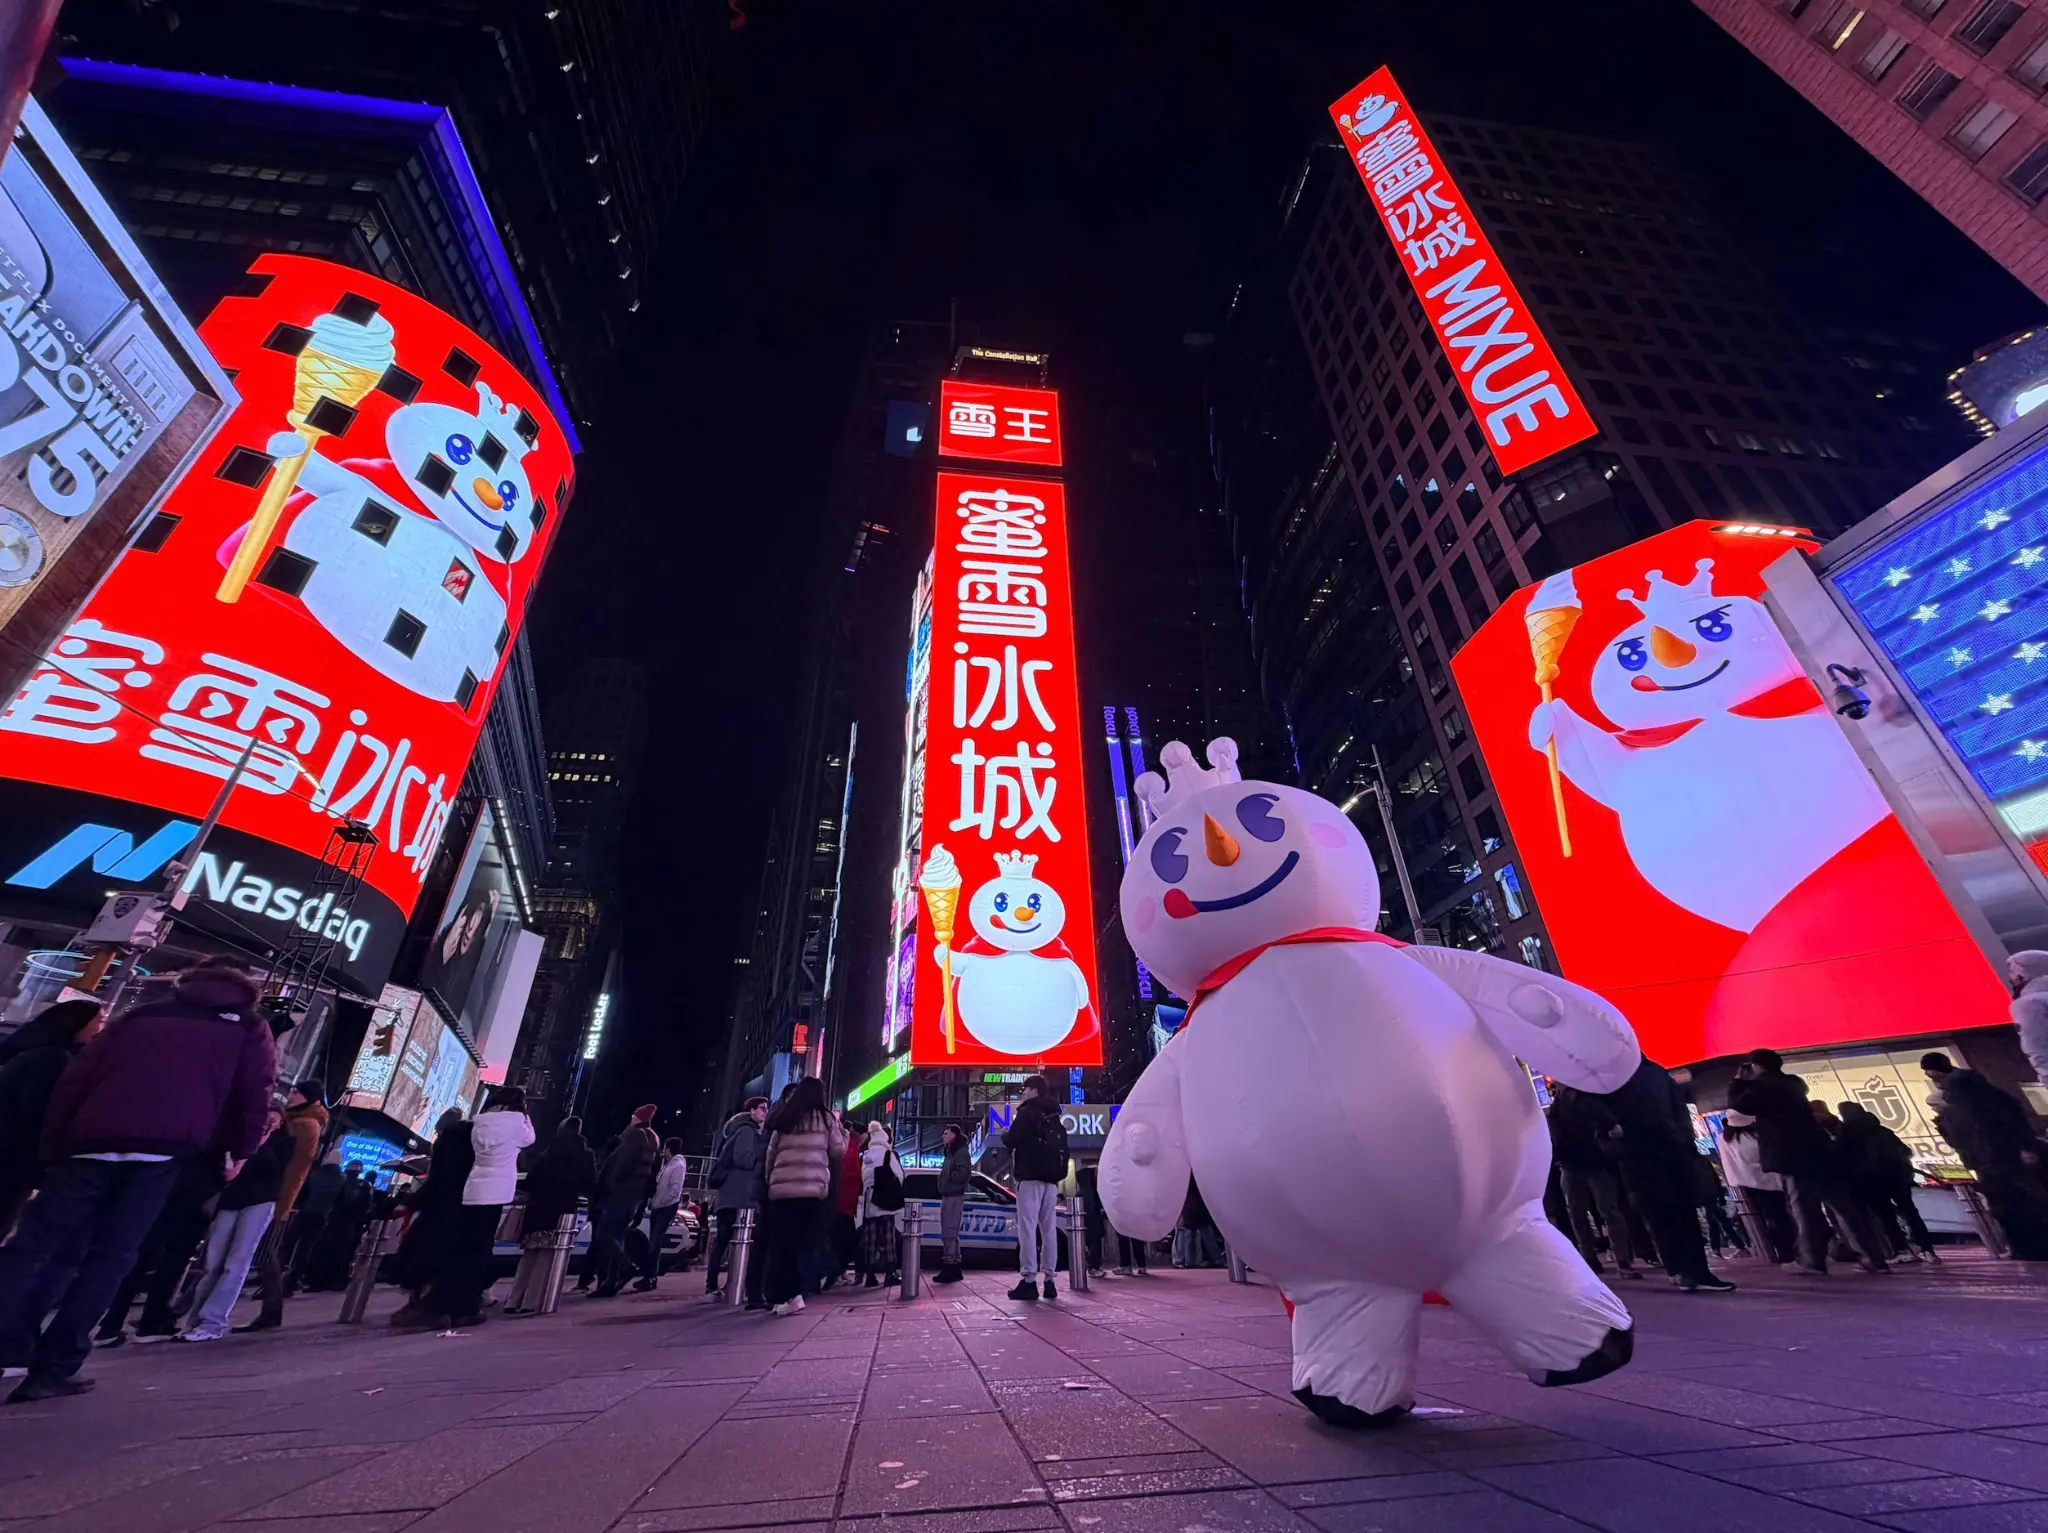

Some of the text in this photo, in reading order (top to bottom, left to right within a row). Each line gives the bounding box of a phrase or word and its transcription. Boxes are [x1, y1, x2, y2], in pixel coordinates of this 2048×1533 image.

[1357, 120, 1569, 446] 蜜雪冰城 MIXUE
[53, 318, 150, 430] DOCUMENTARY
[972, 349, 984, 357] The
[985, 350, 1025, 360] Constellation
[949, 402, 1052, 443] 雪王
[949, 489, 1061, 842] 蜜雪冰城
[181, 852, 371, 961] Nasdaq
[583, 993, 610, 1060] Foot Locker
[1060, 1113, 1104, 1135] ORK
[960, 1214, 1007, 1232] NYPD
